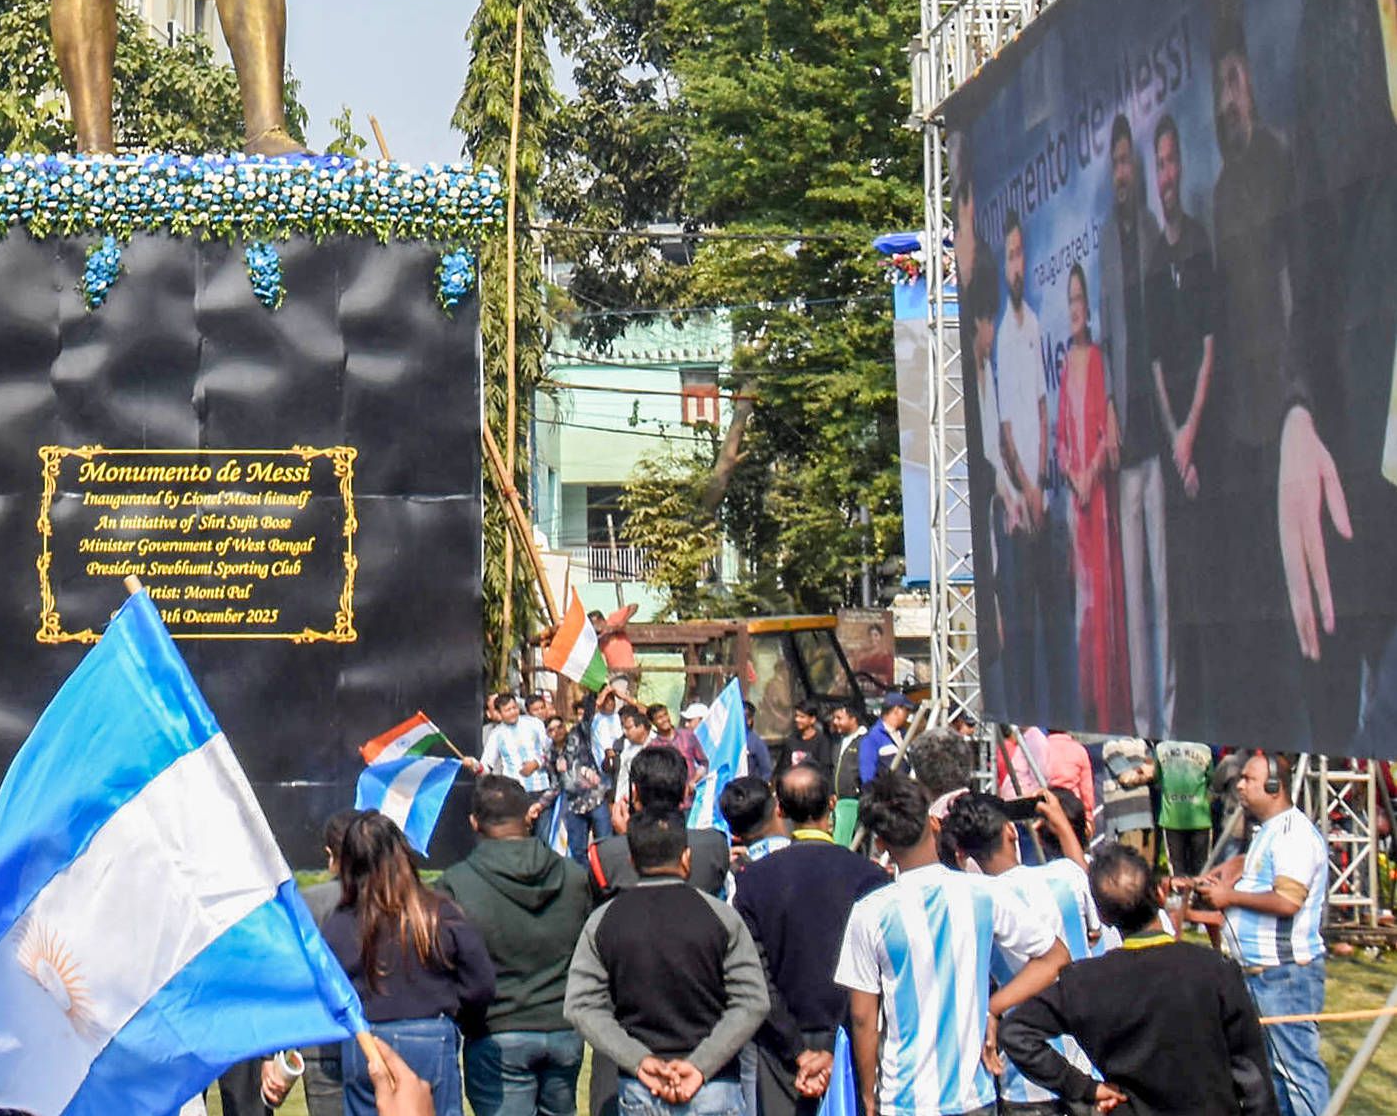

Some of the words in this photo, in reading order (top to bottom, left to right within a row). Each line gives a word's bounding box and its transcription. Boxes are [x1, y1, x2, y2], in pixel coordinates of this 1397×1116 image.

[975, 130, 1069, 246] onumento
[1077, 91, 1104, 169] de
[1116, 14, 1192, 111] Messi
[1033, 224, 1090, 286] naugurated
[79, 462, 212, 482] Monumento
[216, 459, 241, 482] de
[246, 461, 312, 482] Messi
[83, 490, 164, 510] Inaugurated
[164, 490, 179, 509] by
[182, 490, 225, 505] Lionel
[225, 491, 262, 505] Messi
[264, 490, 312, 509] himself
[94, 515, 117, 531] An
[120, 515, 177, 530] initiative
[180, 514, 197, 533] of
[199, 514, 226, 530] Shri
[227, 514, 258, 533] Sujit
[260, 516, 292, 530] Bose
[79, 538, 136, 553] Minister
[137, 538, 213, 556] Government
[215, 536, 233, 556] of
[232, 537, 266, 552] West
[268, 537, 316, 556] Bengal
[86, 559, 146, 575] President
[147, 559, 213, 576] Sreebhumi
[214, 560, 269, 579] Sporting
[271, 560, 302, 576] Club
[184, 585, 225, 599] Monti
[227, 583, 253, 599] Pal
[157, 608, 181, 623] 3th
[183, 607, 245, 623] December
[246, 609, 279, 623] 2025
